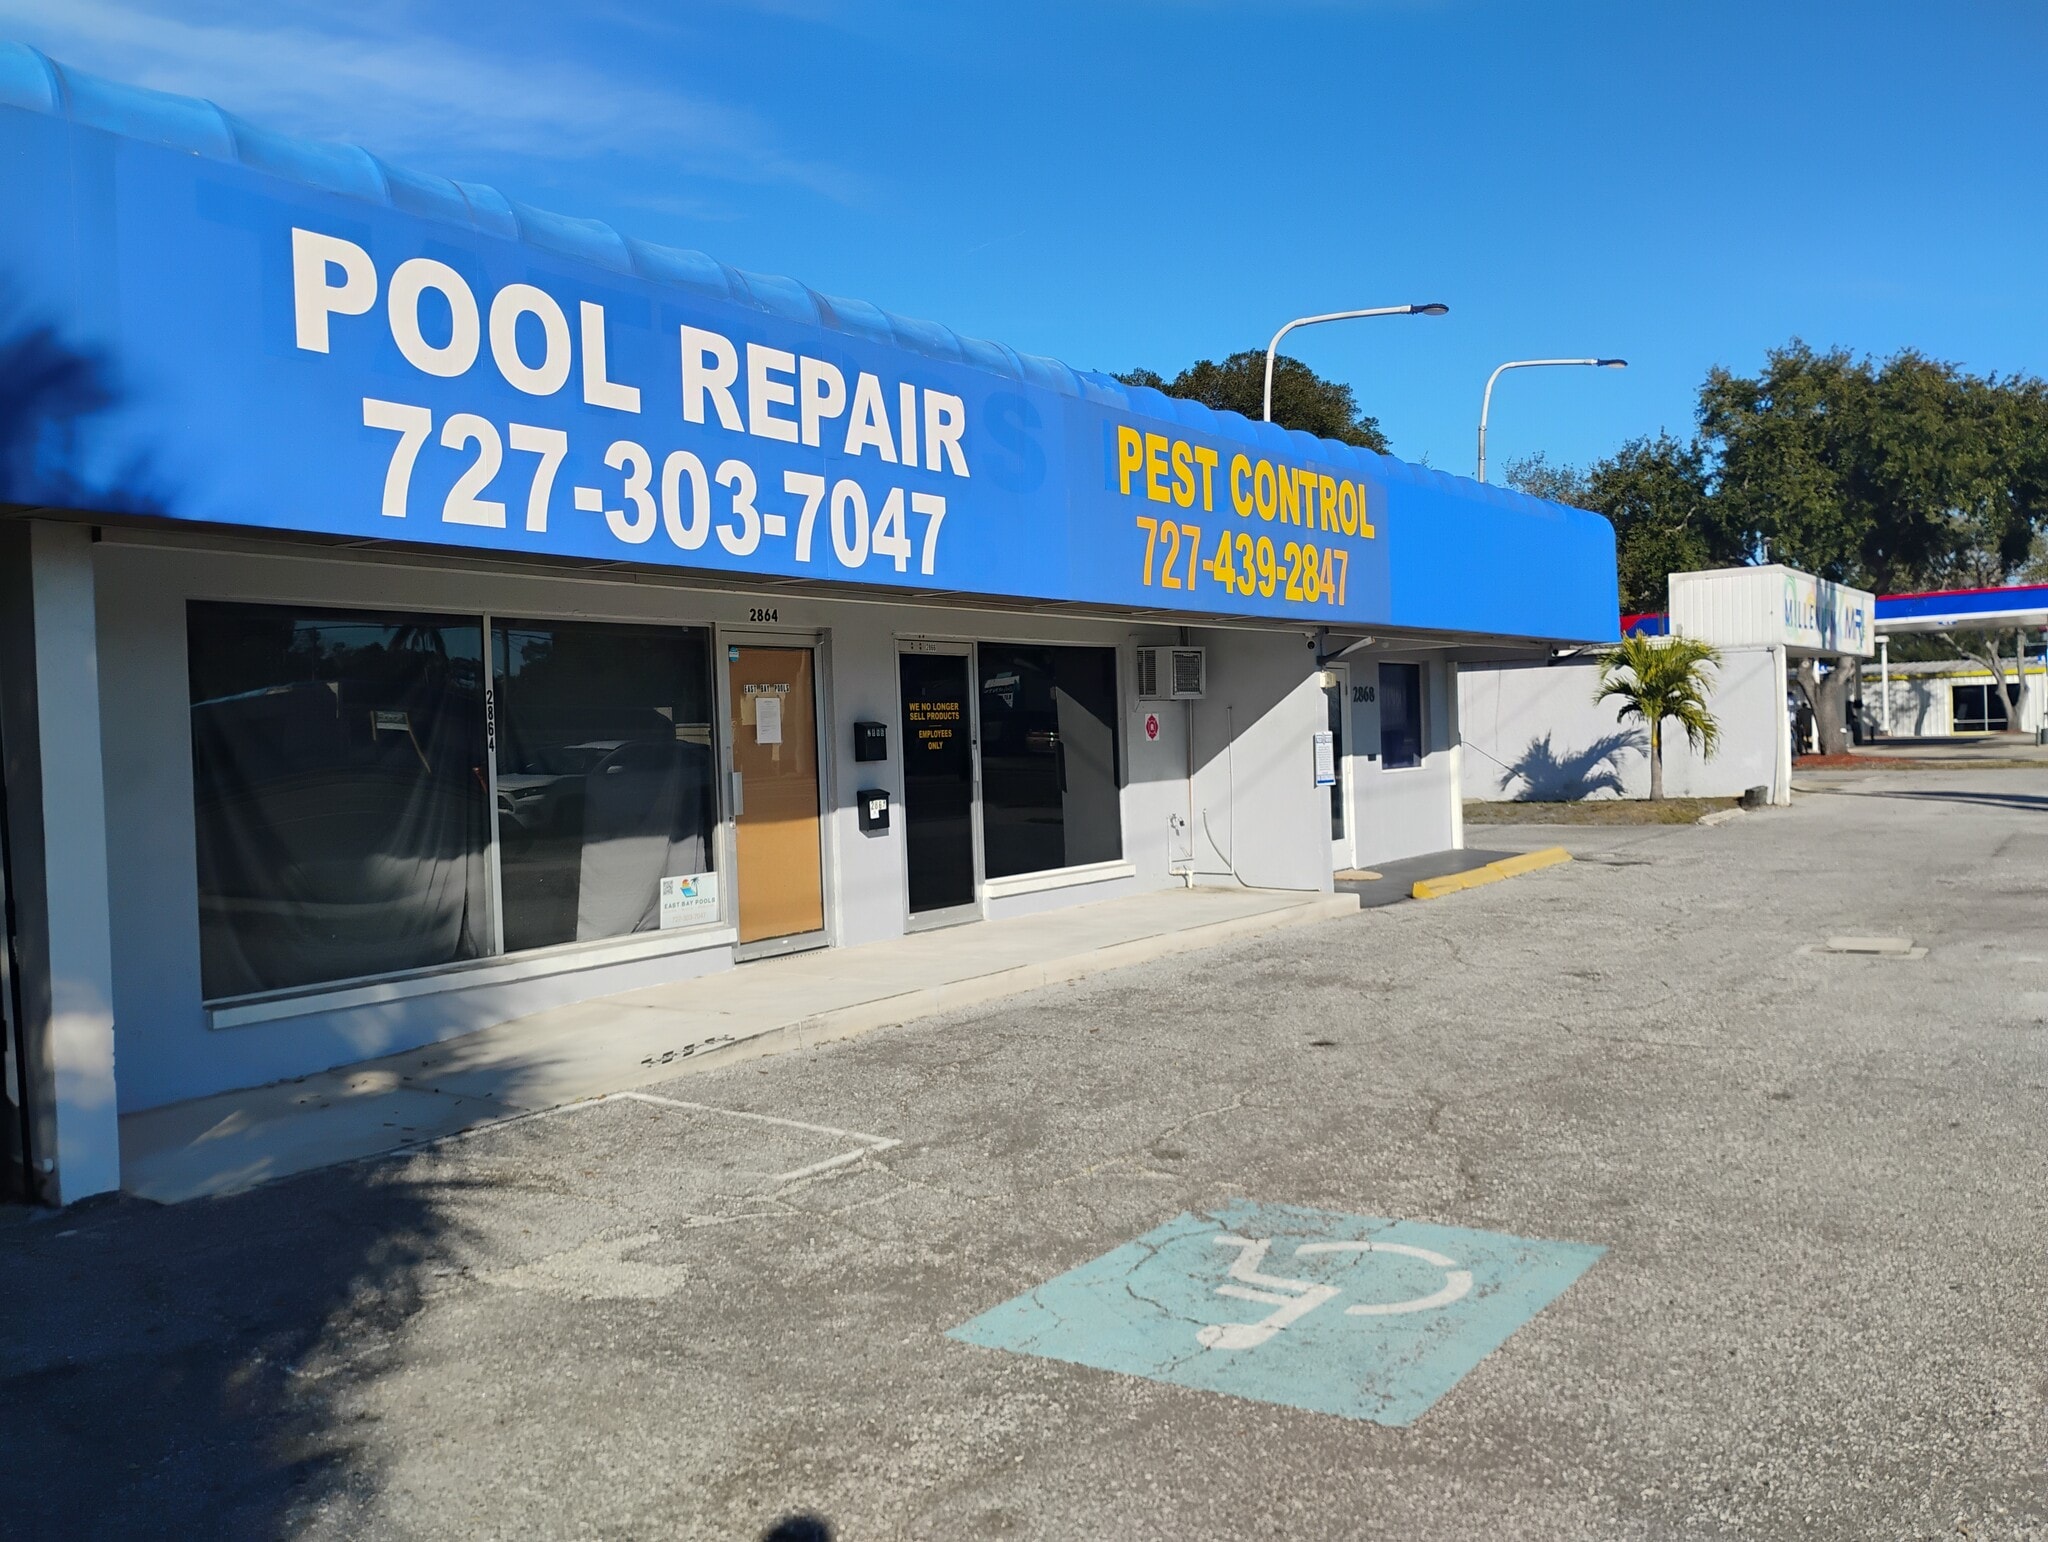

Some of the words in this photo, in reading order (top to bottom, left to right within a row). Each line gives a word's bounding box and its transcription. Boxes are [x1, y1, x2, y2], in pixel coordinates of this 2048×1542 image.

[292, 226, 641, 414] POOL
[680, 324, 970, 478] REPAIR
[362, 397, 946, 576] 727-303-7047
[1118, 425, 1218, 512] PEST
[1230, 453, 1375, 539] CONTROL
[1136, 516, 1348, 606] 727-439-2847
[749, 608, 778, 622] 2864
[1353, 686, 1375, 702] 2868
[909, 702, 920, 711] WE
[921, 702, 931, 711] NO
[933, 702, 959, 711] LONGER
[486, 690, 495, 752] 2864
[909, 712, 925, 721] SELL
[927, 712, 960, 720] PRODUCTS
[918, 730, 952, 738] EMPLOYEES
[928, 742, 943, 750] ONLY
[695, 897, 716, 905] POOLS
